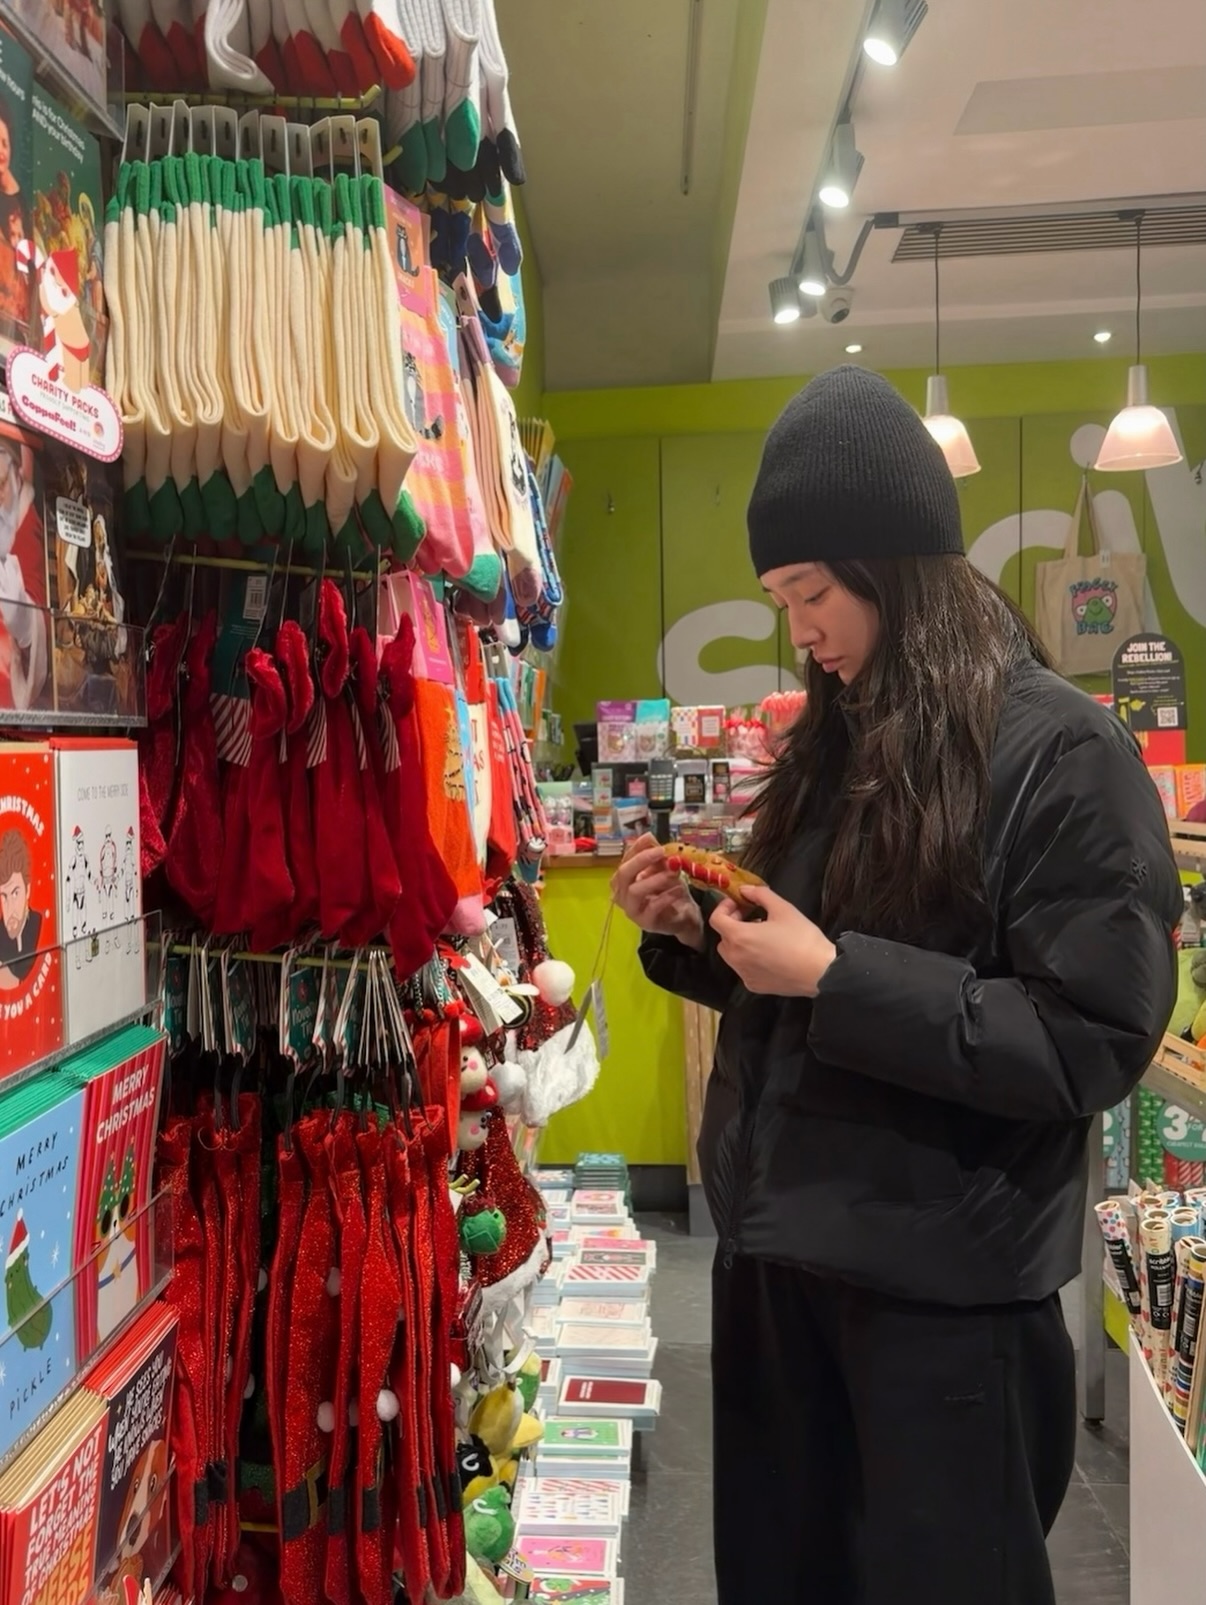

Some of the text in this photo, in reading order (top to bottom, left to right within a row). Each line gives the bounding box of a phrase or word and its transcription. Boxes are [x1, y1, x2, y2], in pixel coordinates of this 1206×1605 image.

[22, 395, 76, 432] CoppaFeel!
[31, 373, 99, 419] CHARITY PACKS
[1122, 652, 1173, 663] REBELLION!
[1127, 641, 1166, 652] JOIN THE
[0, 795, 44, 836] HRISTMAS
[4, 952, 52, 1020] YOU A CARD
[112, 1064, 149, 1106] MERRY
[96, 1087, 155, 1144] CHRISTMAS
[1163, 1104, 1189, 1140] 3
[15, 1131, 58, 1176] MERRY
[30, 1465, 70, 1537] LET'S
[73, 1425, 102, 1483] NOT
[27, 1453, 100, 1567] FORGET THE
[25, 1540, 51, 1589] TRUE
[53, 1479, 97, 1549] MEANING
[38, 1497, 96, 1590] CHRISTMAS
